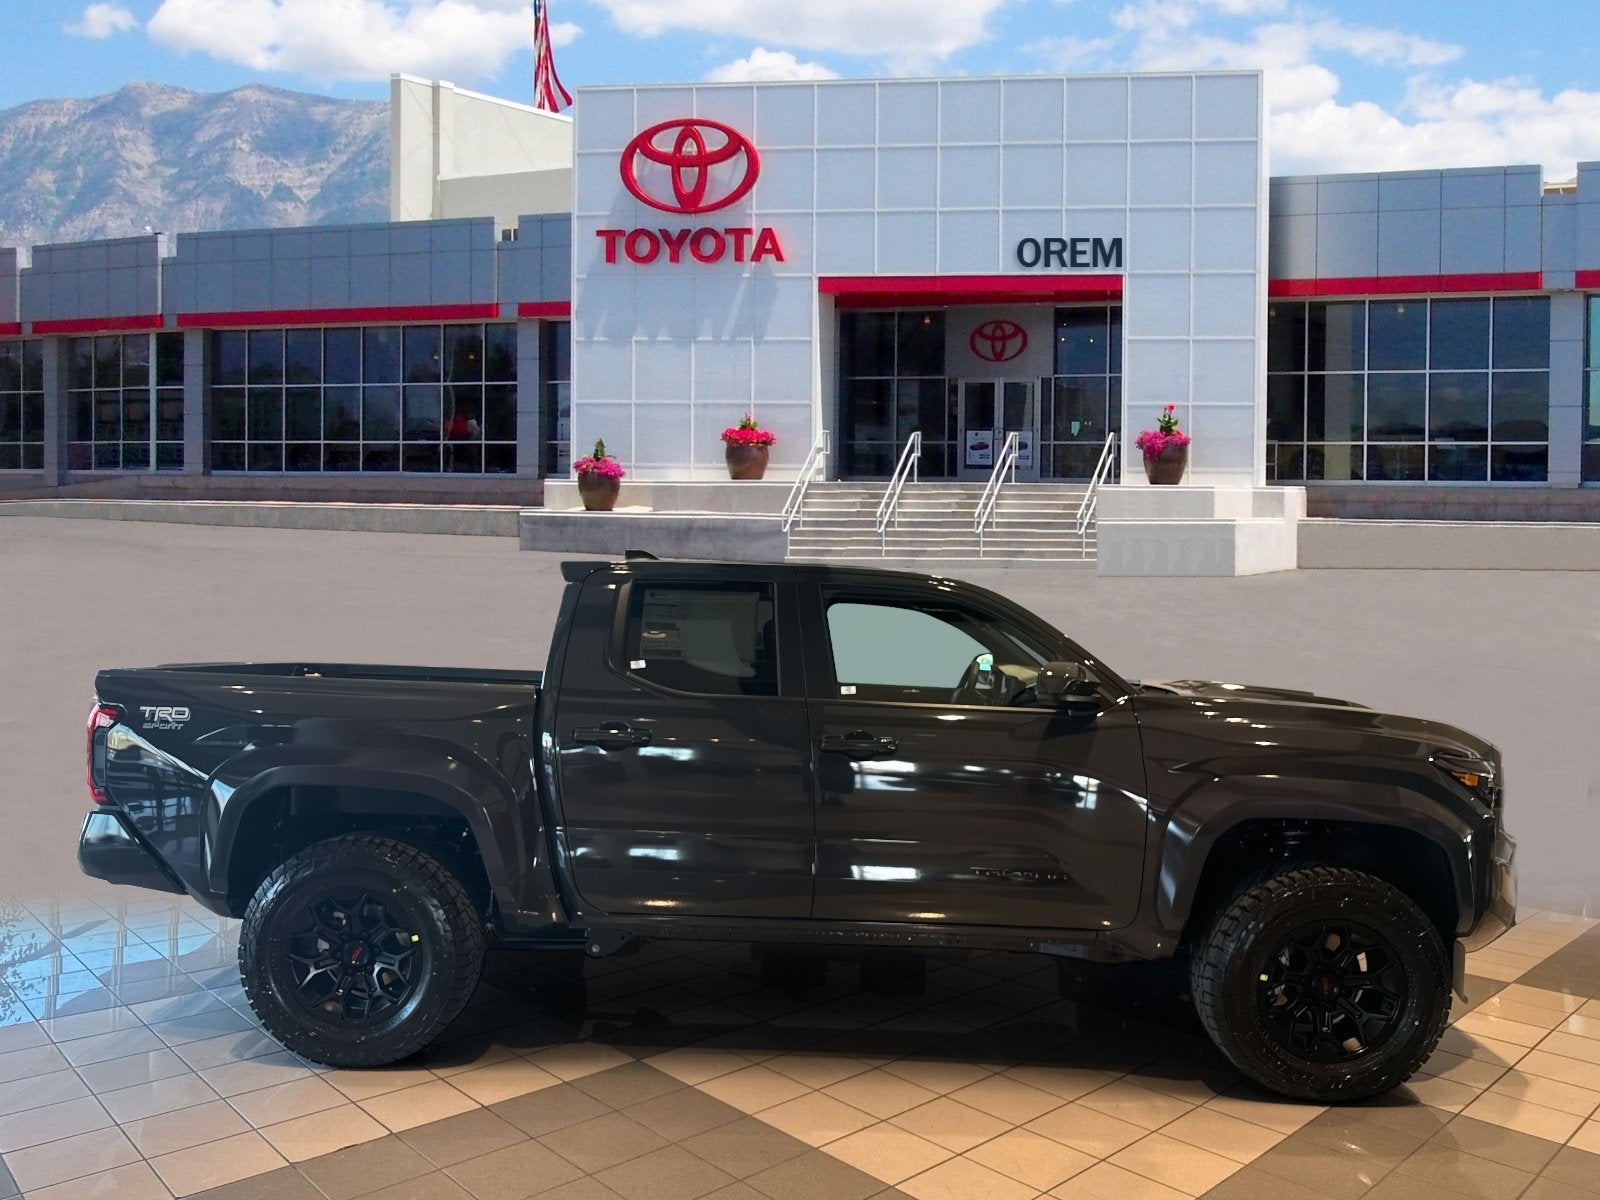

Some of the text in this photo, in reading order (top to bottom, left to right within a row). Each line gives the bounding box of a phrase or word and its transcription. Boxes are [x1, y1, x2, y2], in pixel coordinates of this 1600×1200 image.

[596, 227, 785, 264] TOYOTA
[1016, 237, 1123, 268] OREM
[139, 706, 191, 722] TRD
